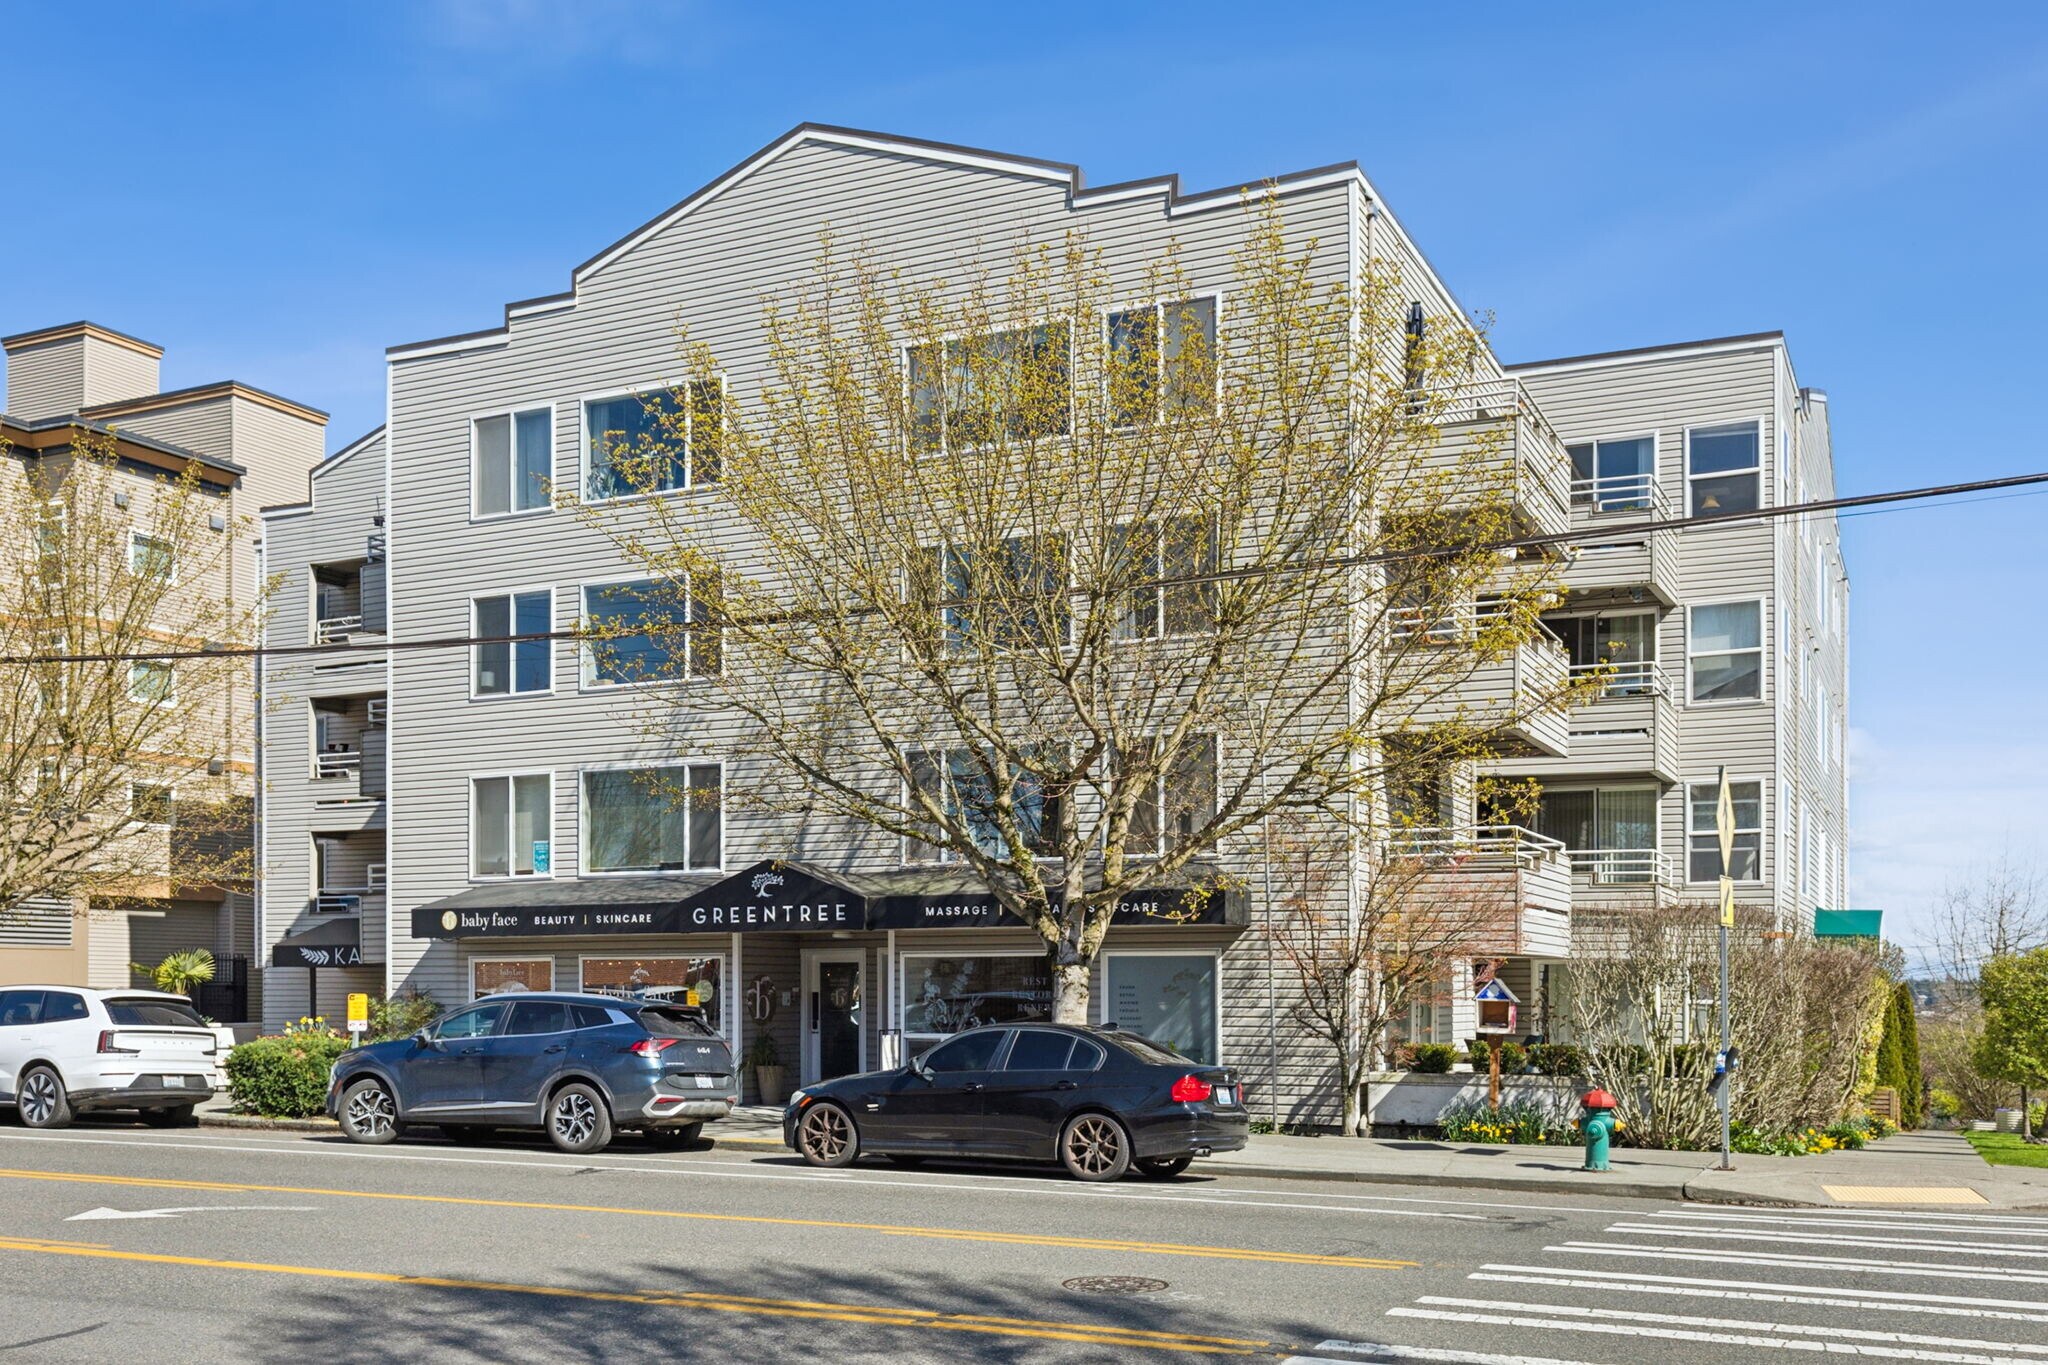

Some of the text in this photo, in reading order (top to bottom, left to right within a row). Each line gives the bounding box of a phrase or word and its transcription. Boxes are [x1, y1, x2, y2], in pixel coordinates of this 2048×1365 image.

[692, 903, 846, 924] GREENTREE
[925, 905, 988, 916] MASSAGE
[461, 912, 518, 931] baby face
[534, 914, 652, 925] BEAUTY SKINCARE
[1022, 976, 1047, 985] REST
